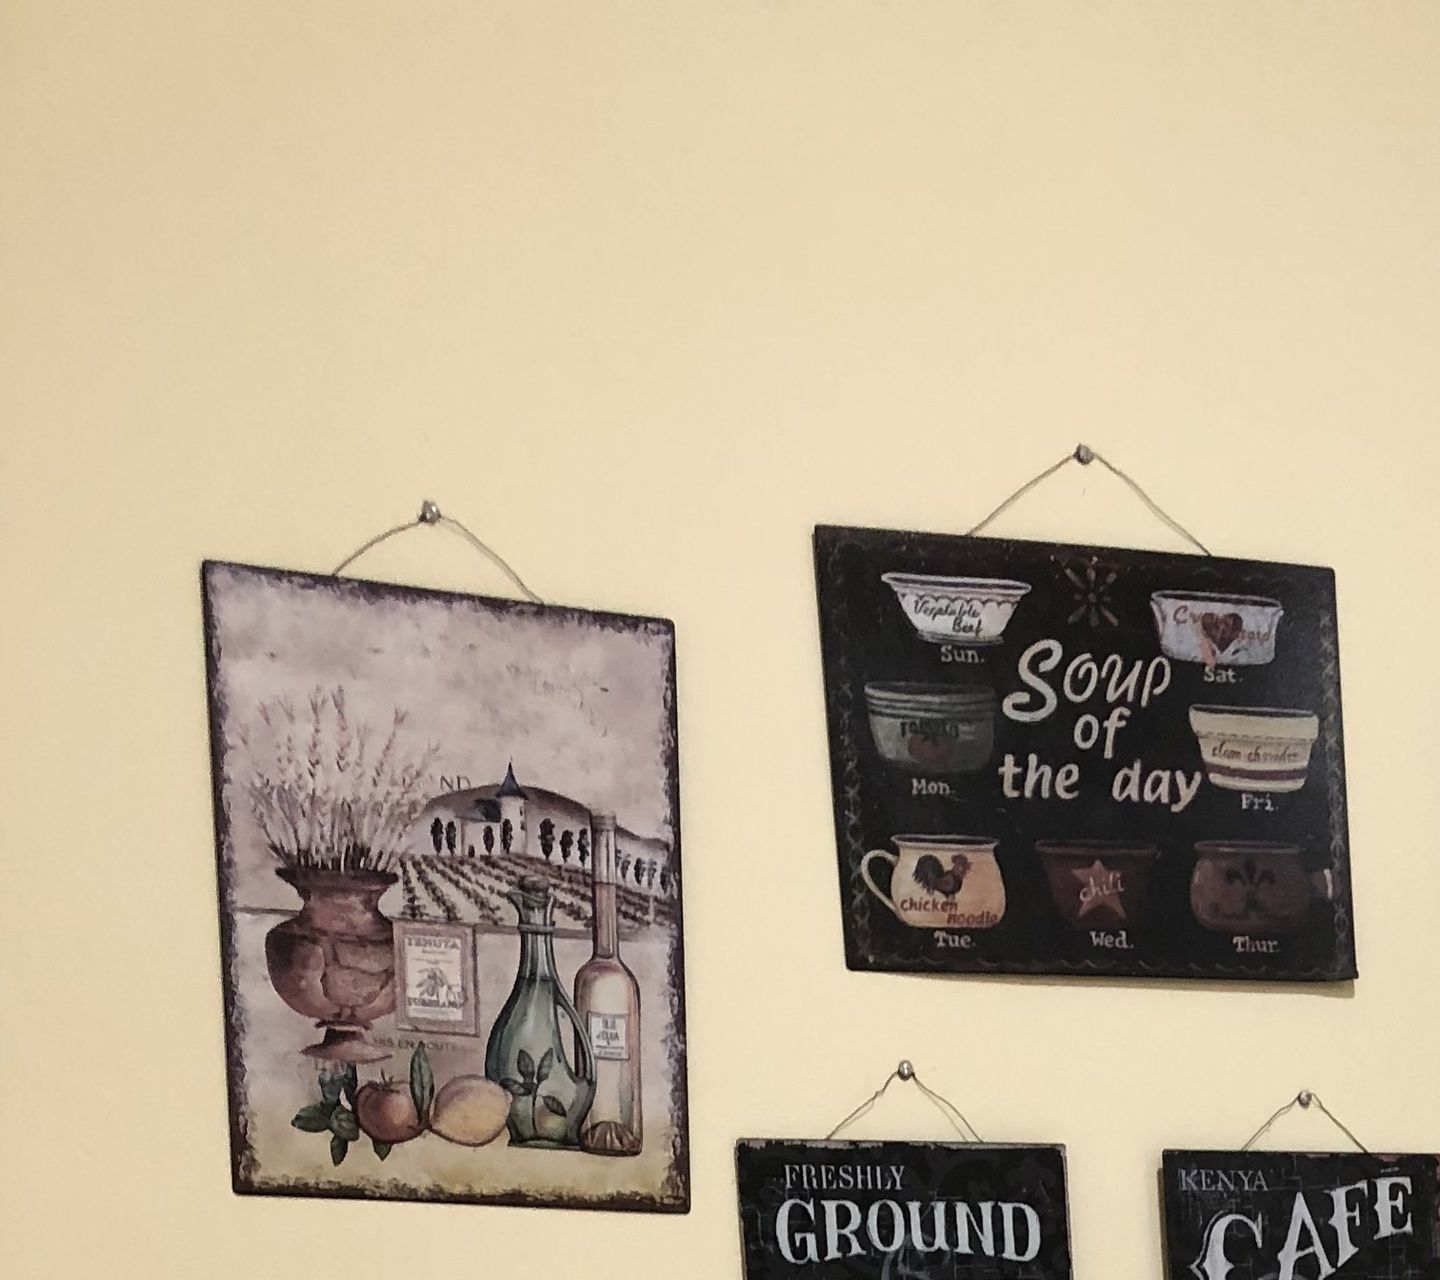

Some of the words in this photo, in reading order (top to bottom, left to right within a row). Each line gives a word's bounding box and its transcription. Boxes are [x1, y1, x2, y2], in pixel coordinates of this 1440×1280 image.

[940, 644, 985, 663] Sun.
[1002, 639, 1171, 722] Soup
[1203, 666, 1243, 684] Sat.
[1074, 706, 1132, 759] of
[998, 752, 1080, 800] the
[1111, 757, 1202, 814] day
[1079, 871, 1125, 902] chili
[900, 897, 958, 913] chicken
[946, 910, 999, 926] noodle
[1089, 930, 1135, 949] Wed.
[784, 1164, 905, 1190] FRESHLY
[1178, 1168, 1269, 1192] KENYA
[775, 1198, 1042, 1265] GROUND
